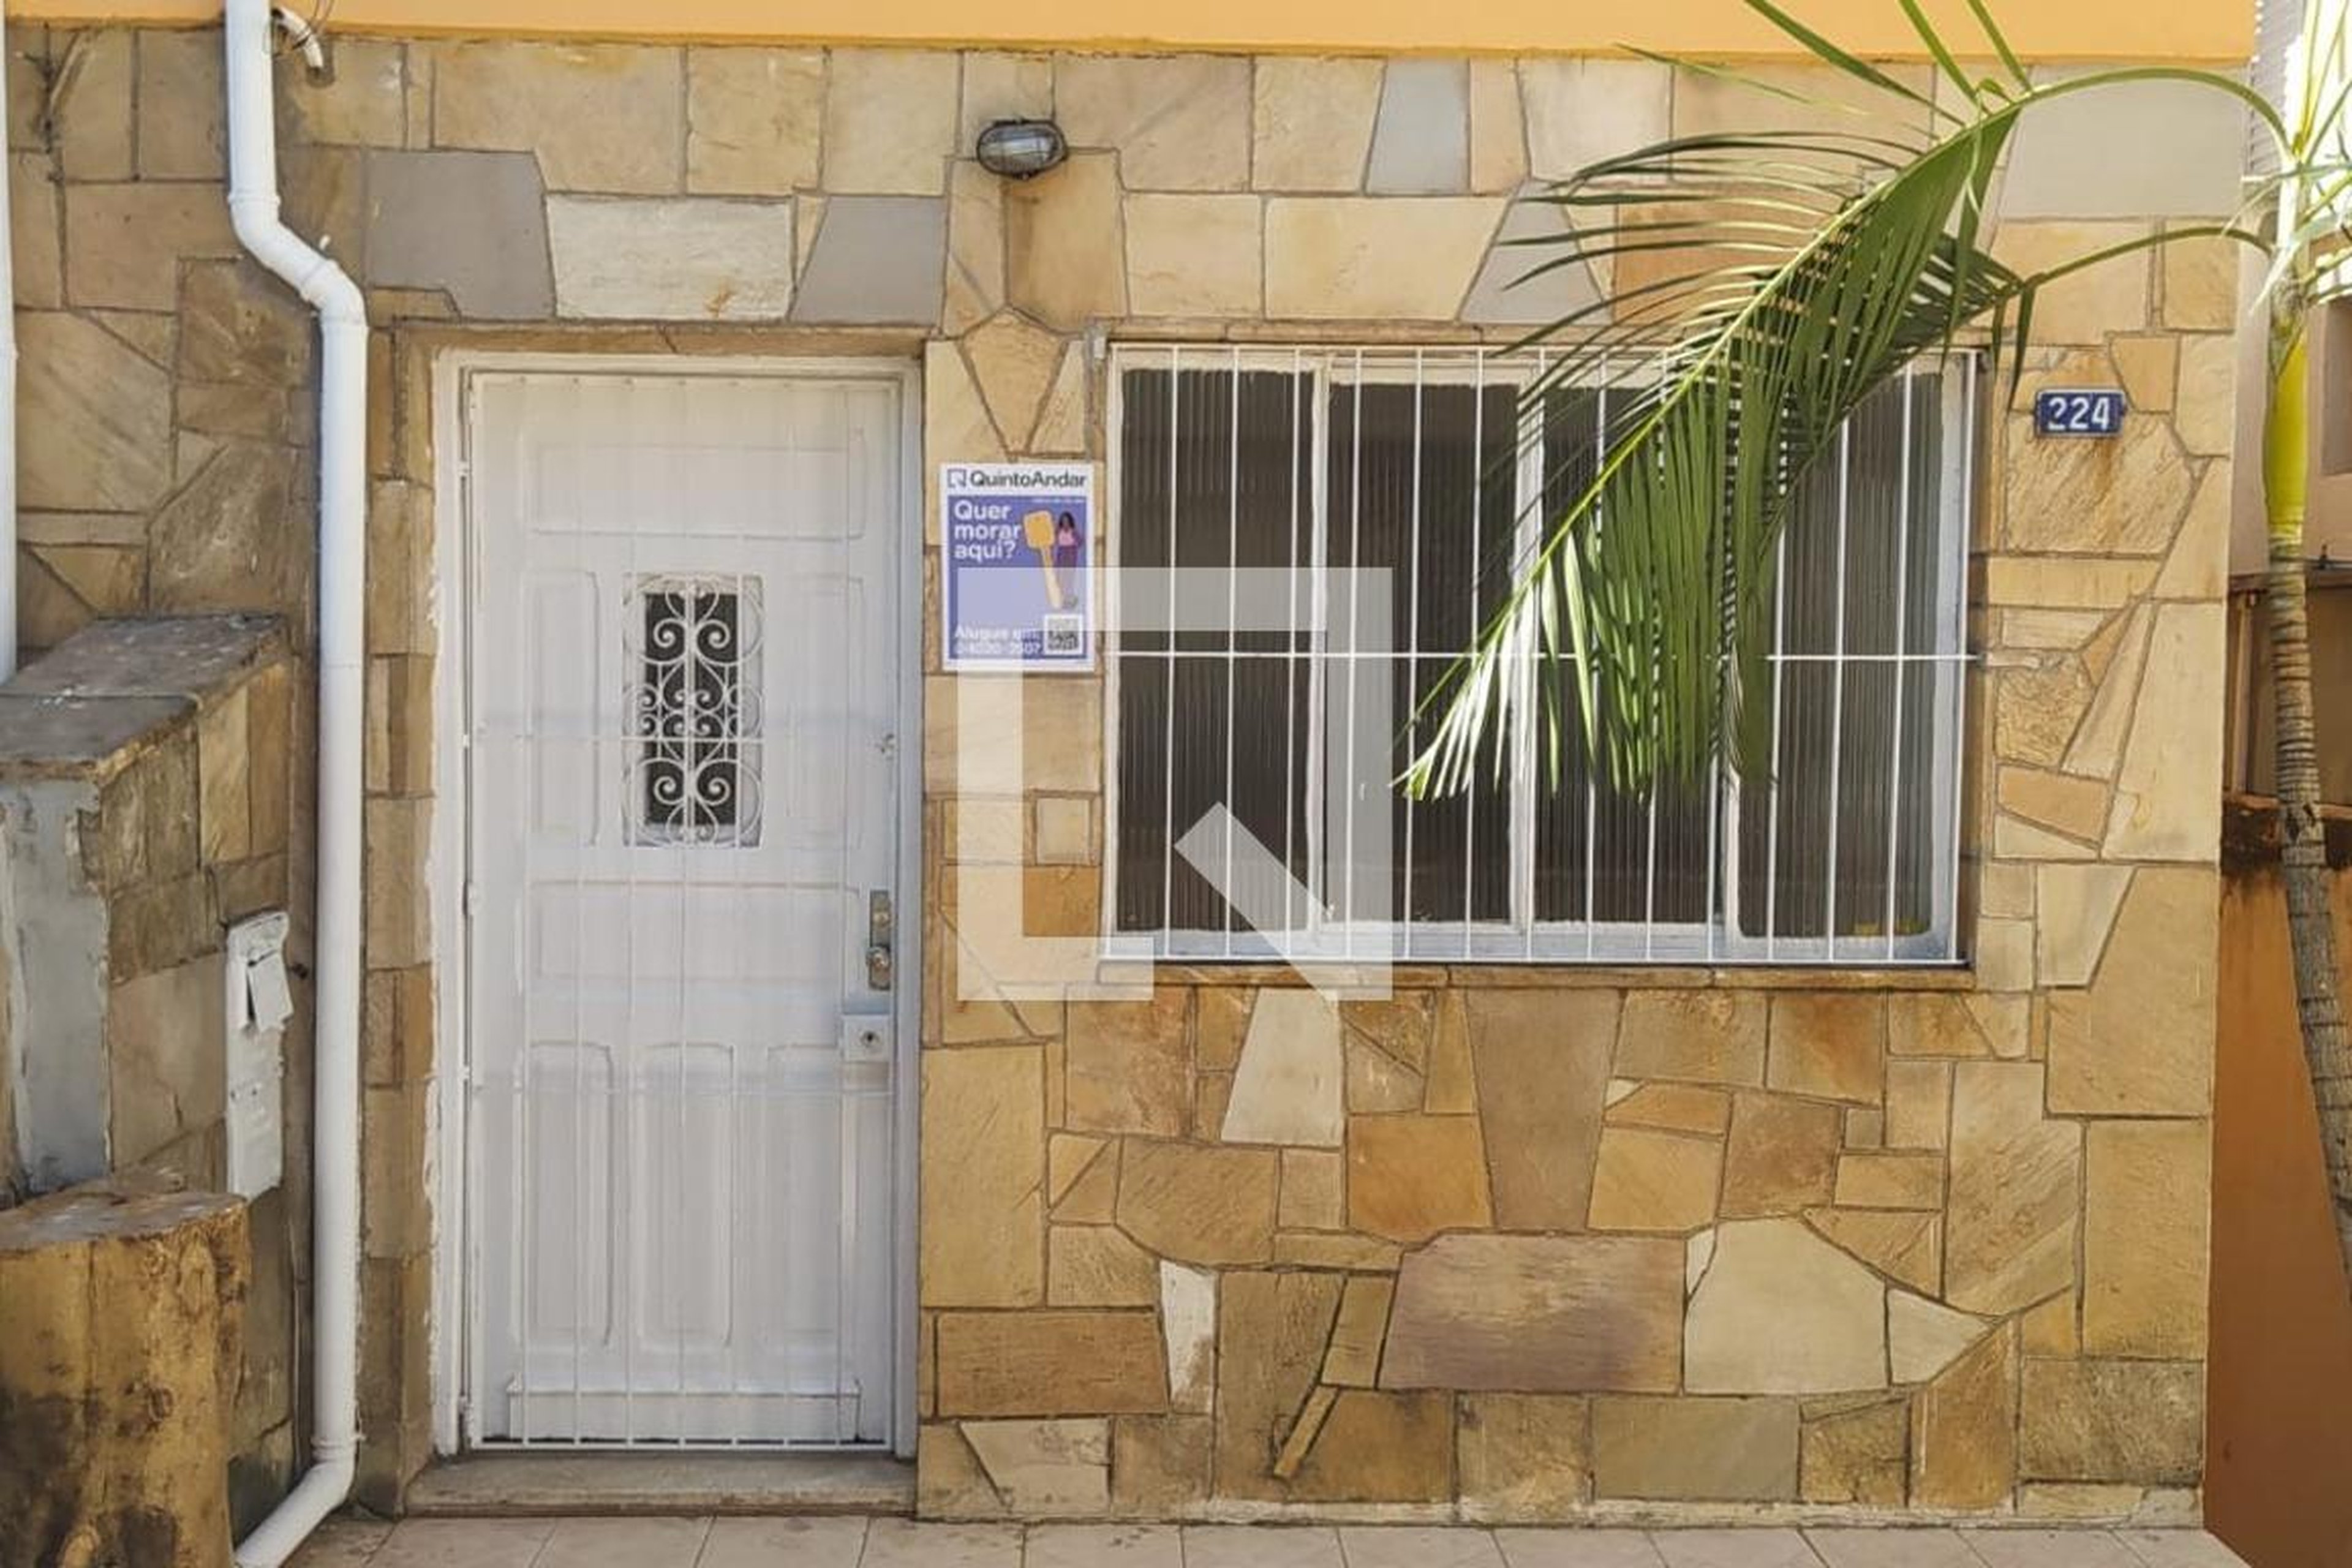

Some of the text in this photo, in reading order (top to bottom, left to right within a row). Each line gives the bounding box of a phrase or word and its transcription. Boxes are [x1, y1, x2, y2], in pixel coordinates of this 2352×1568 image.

[2048, 396, 2109, 431] 224
[970, 470, 1087, 488] QuintoAndar
[954, 499, 1011, 520] Quer
[954, 522, 1022, 540] morar
[954, 541, 1016, 562] aqui?
